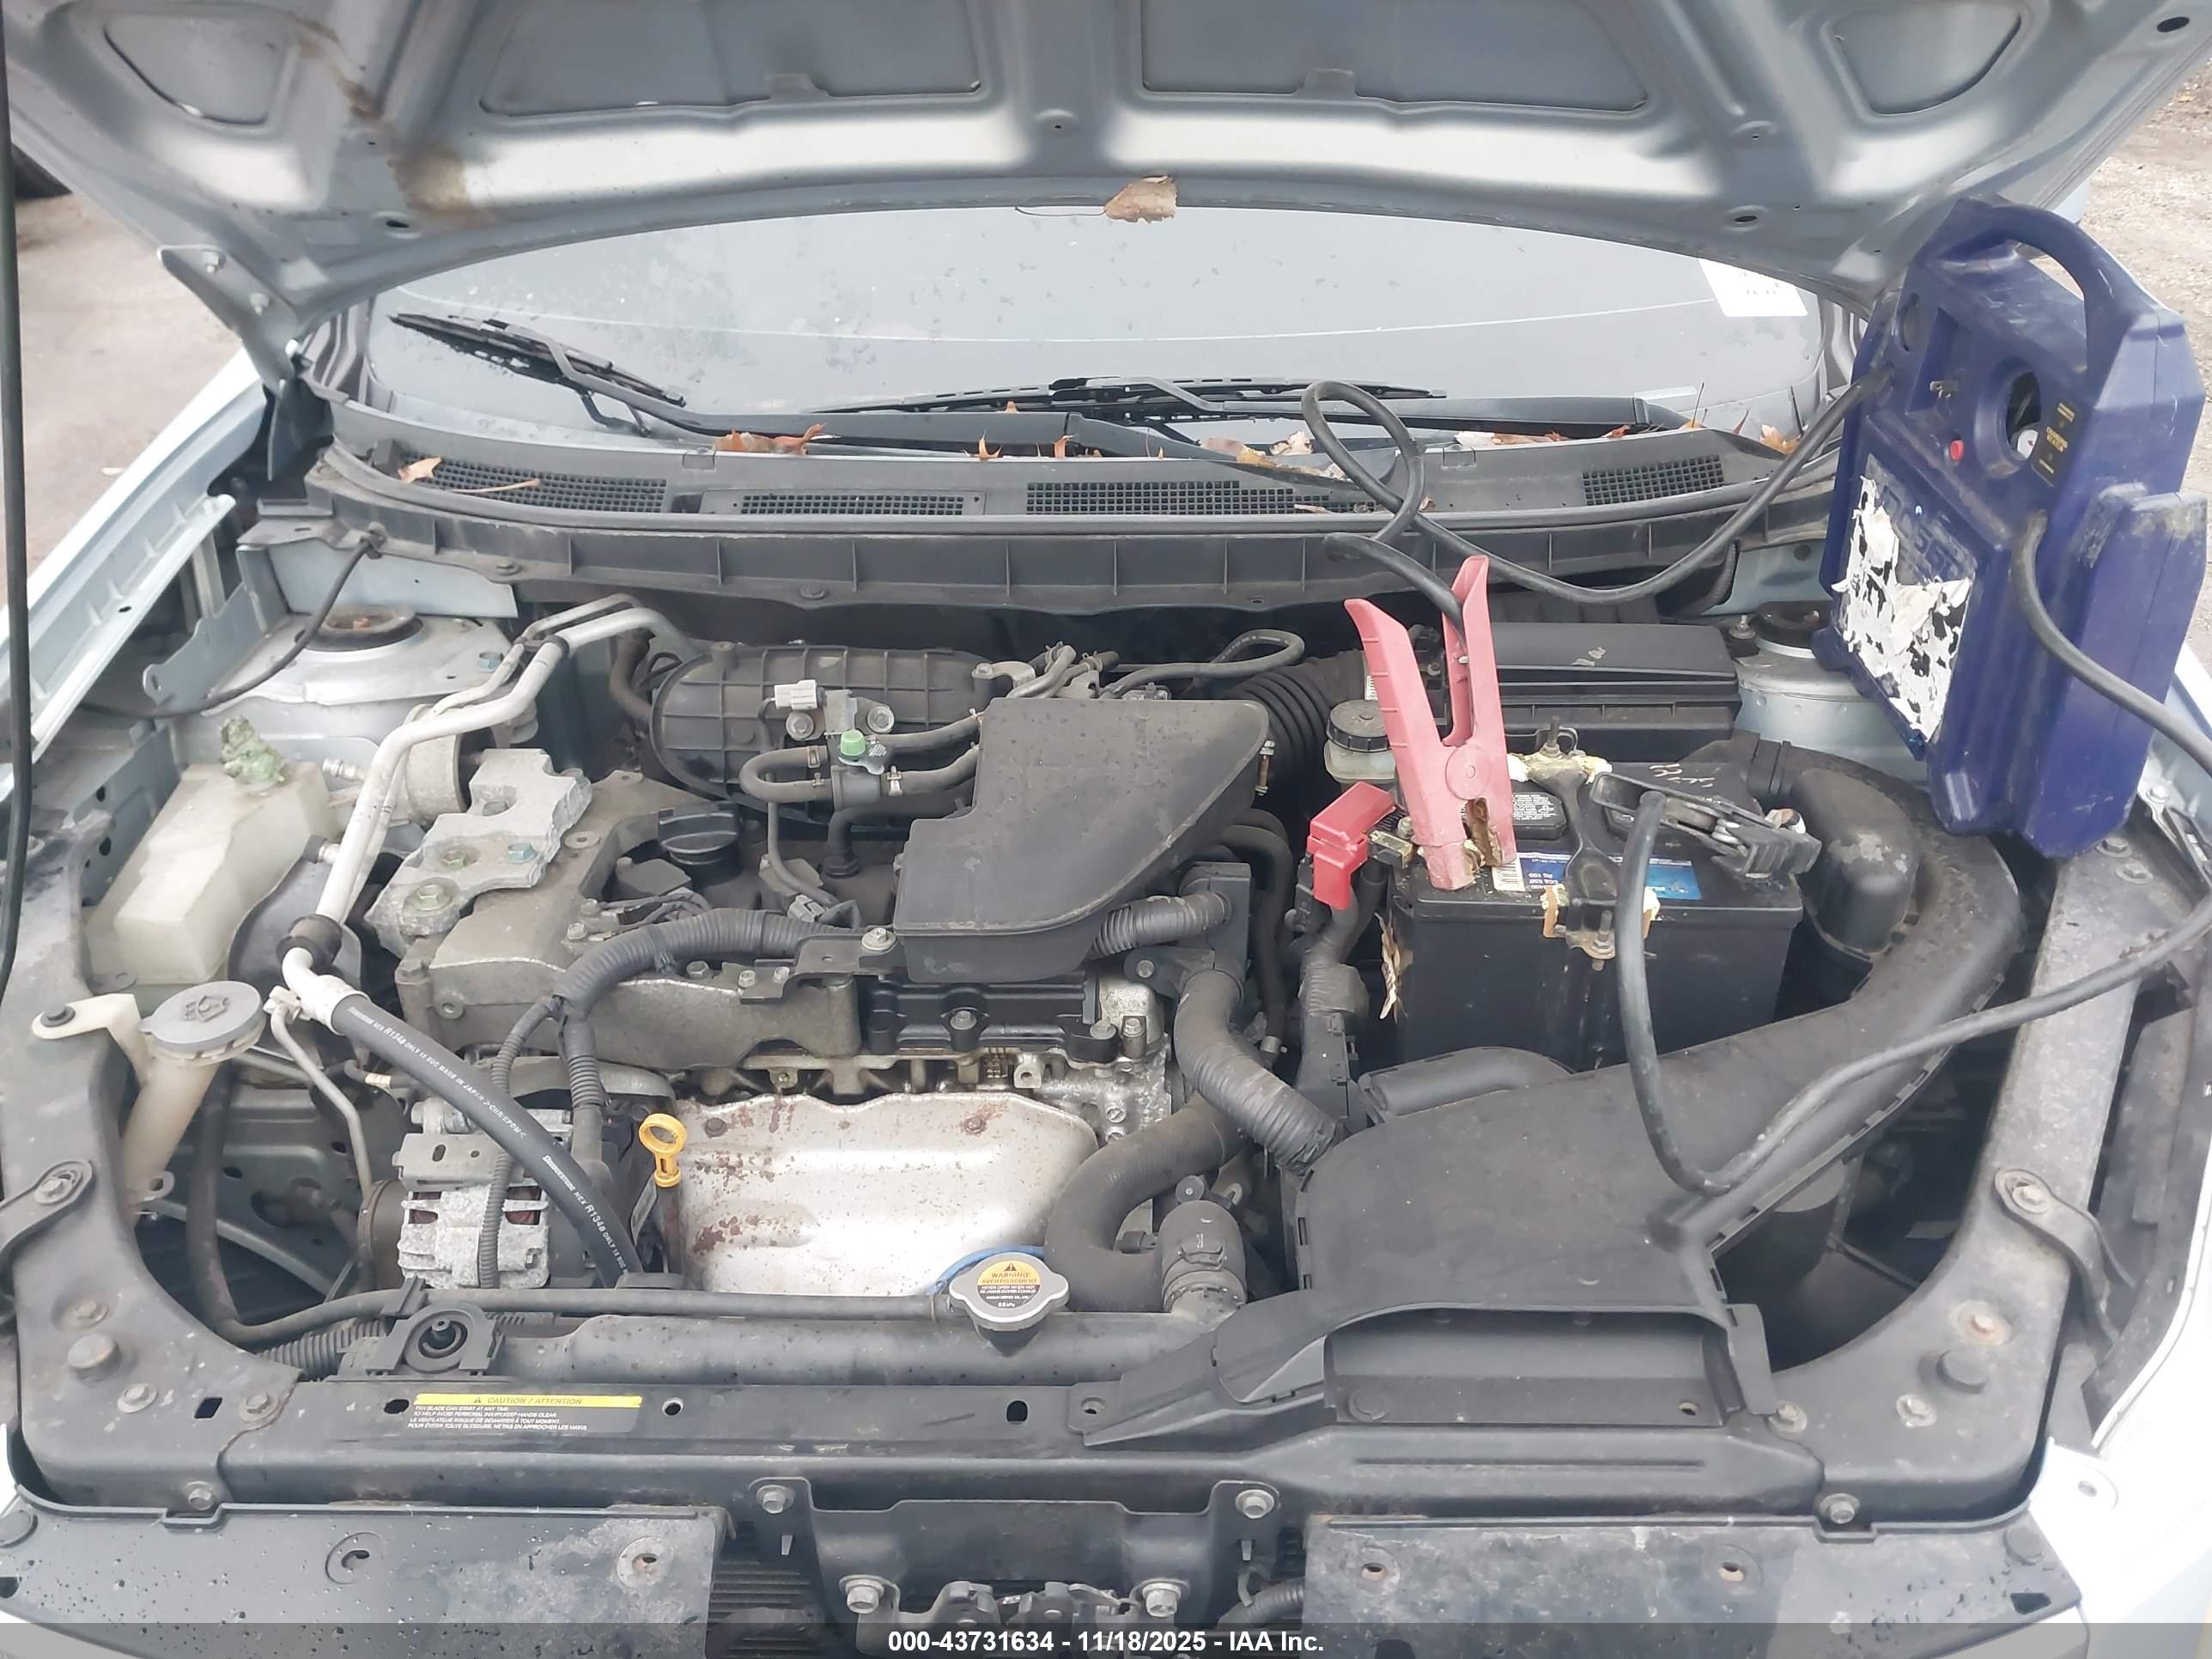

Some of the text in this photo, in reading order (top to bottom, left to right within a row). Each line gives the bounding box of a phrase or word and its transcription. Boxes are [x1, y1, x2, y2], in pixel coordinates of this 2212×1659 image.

[439, 1065, 457, 1079] MADE
[463, 1085, 485, 1101] JAPAN
[603, 1231, 617, 1249] ONLY
